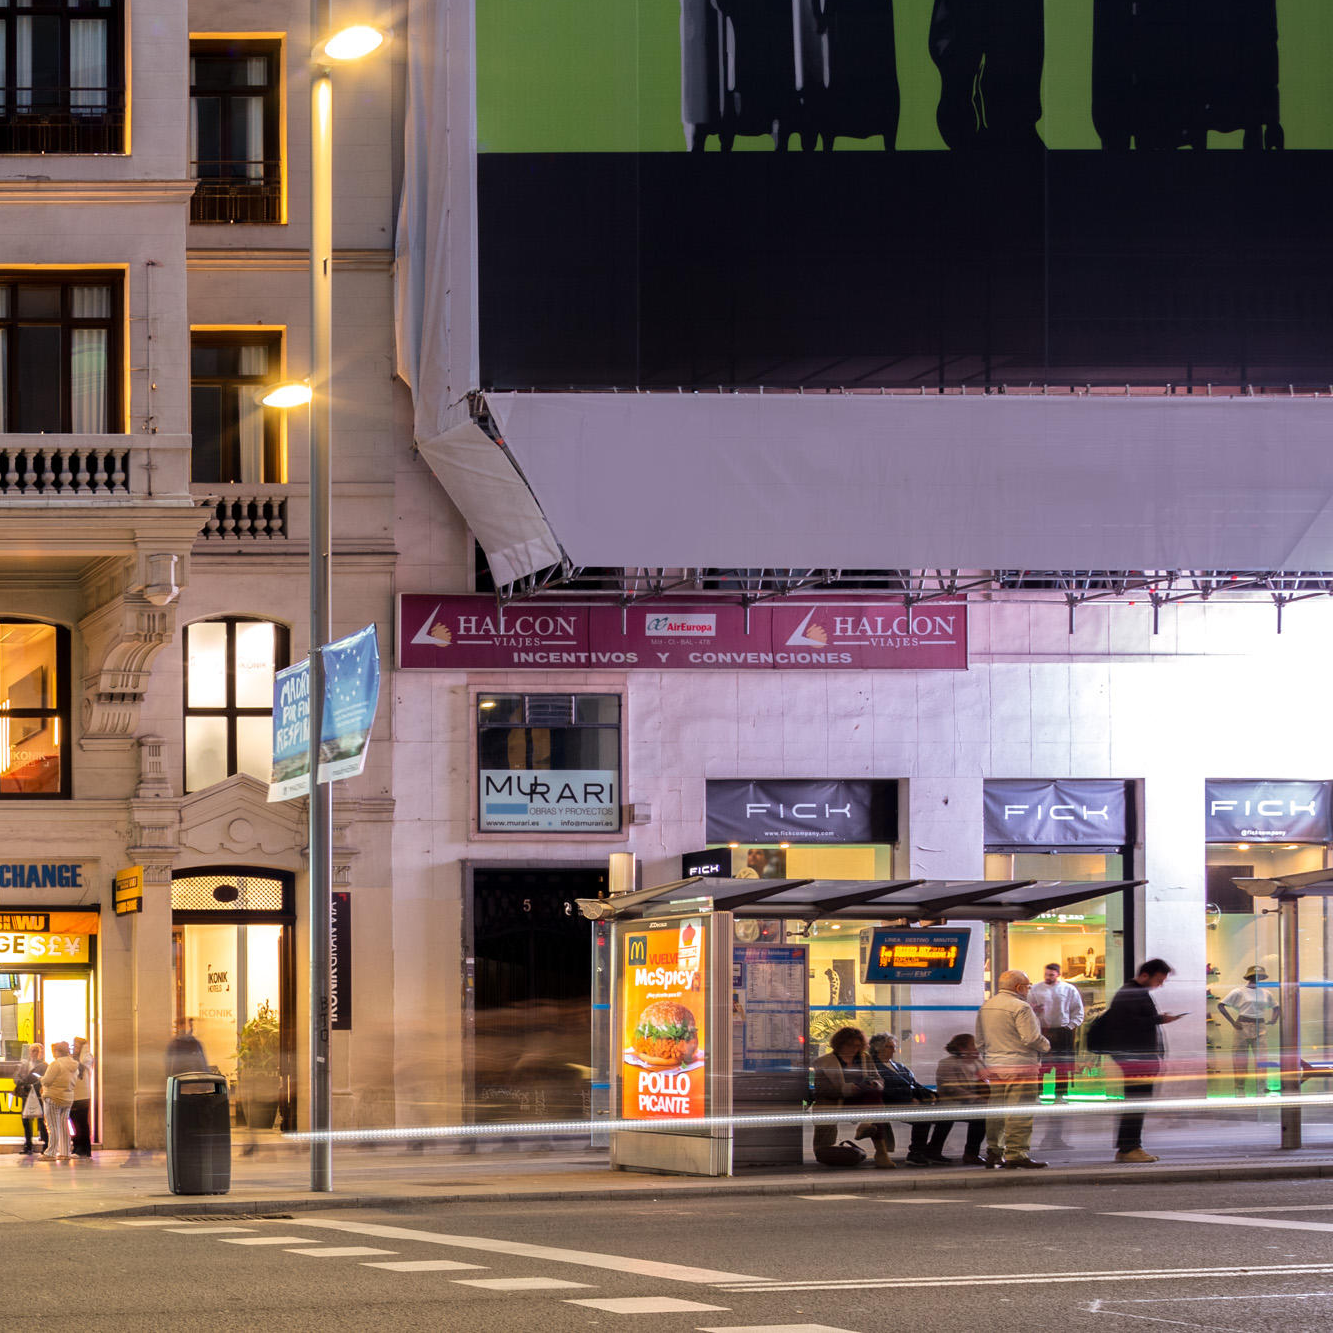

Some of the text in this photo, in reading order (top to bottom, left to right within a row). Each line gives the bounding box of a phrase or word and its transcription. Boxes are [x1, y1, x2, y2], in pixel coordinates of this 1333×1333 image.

[457, 616, 577, 636] HALCON
[667, 622, 712, 633] AirEuropa
[834, 616, 956, 636] HALCON
[492, 637, 541, 647] VIAJES
[869, 637, 919, 647] VIAJES
[513, 652, 853, 664] INCENTIVOS Y CONVENCIONES
[486, 775, 613, 804] MURARI
[529, 807, 614, 816] OBRAS Y PROYECTOS
[746, 803, 851, 818] FICK
[1004, 805, 1109, 820] FICK
[1211, 800, 1316, 816] FICK
[561, 819, 614, 827] info@murari.es
[689, 864, 720, 876] FICK
[16, 915, 45, 931] WU
[208, 972, 228, 984] IKONIK
[635, 966, 697, 990] McSpicy
[208, 984, 222, 993] HOTELS
[638, 1071, 690, 1095] POLLO
[638, 1094, 690, 1114] PICANTE
